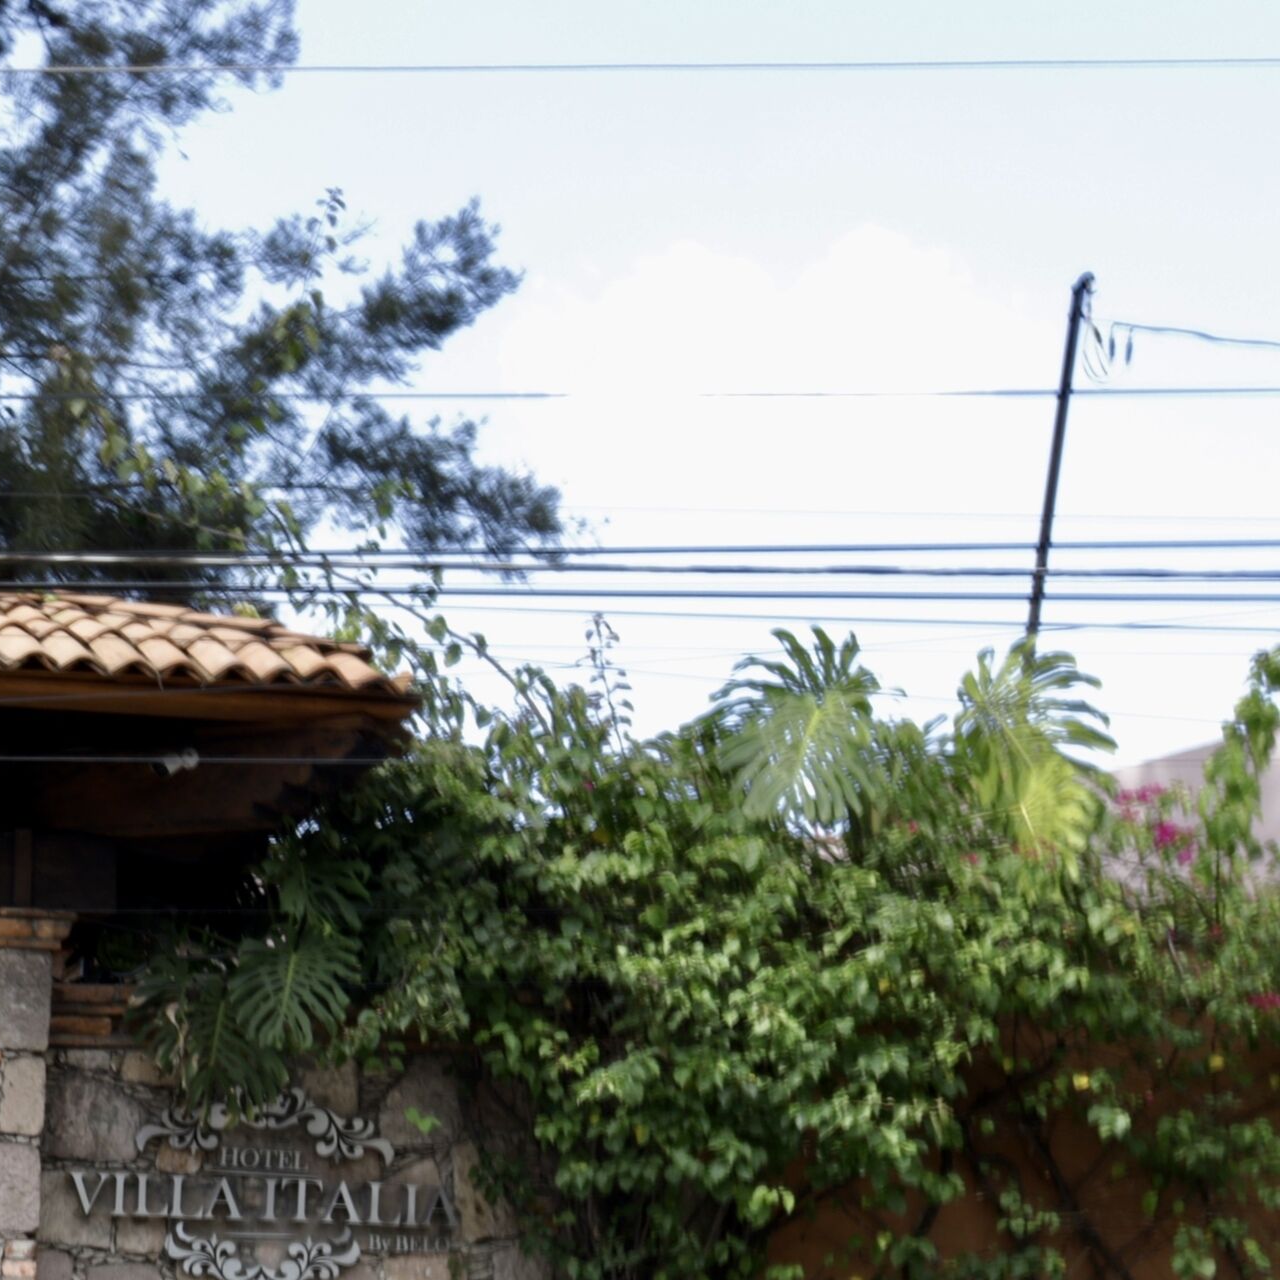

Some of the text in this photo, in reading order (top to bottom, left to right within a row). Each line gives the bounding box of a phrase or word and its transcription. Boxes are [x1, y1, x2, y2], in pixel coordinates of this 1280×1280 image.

[218, 1146, 309, 1171] HOTEL
[69, 1170, 458, 1228] VILLA ITALIA
